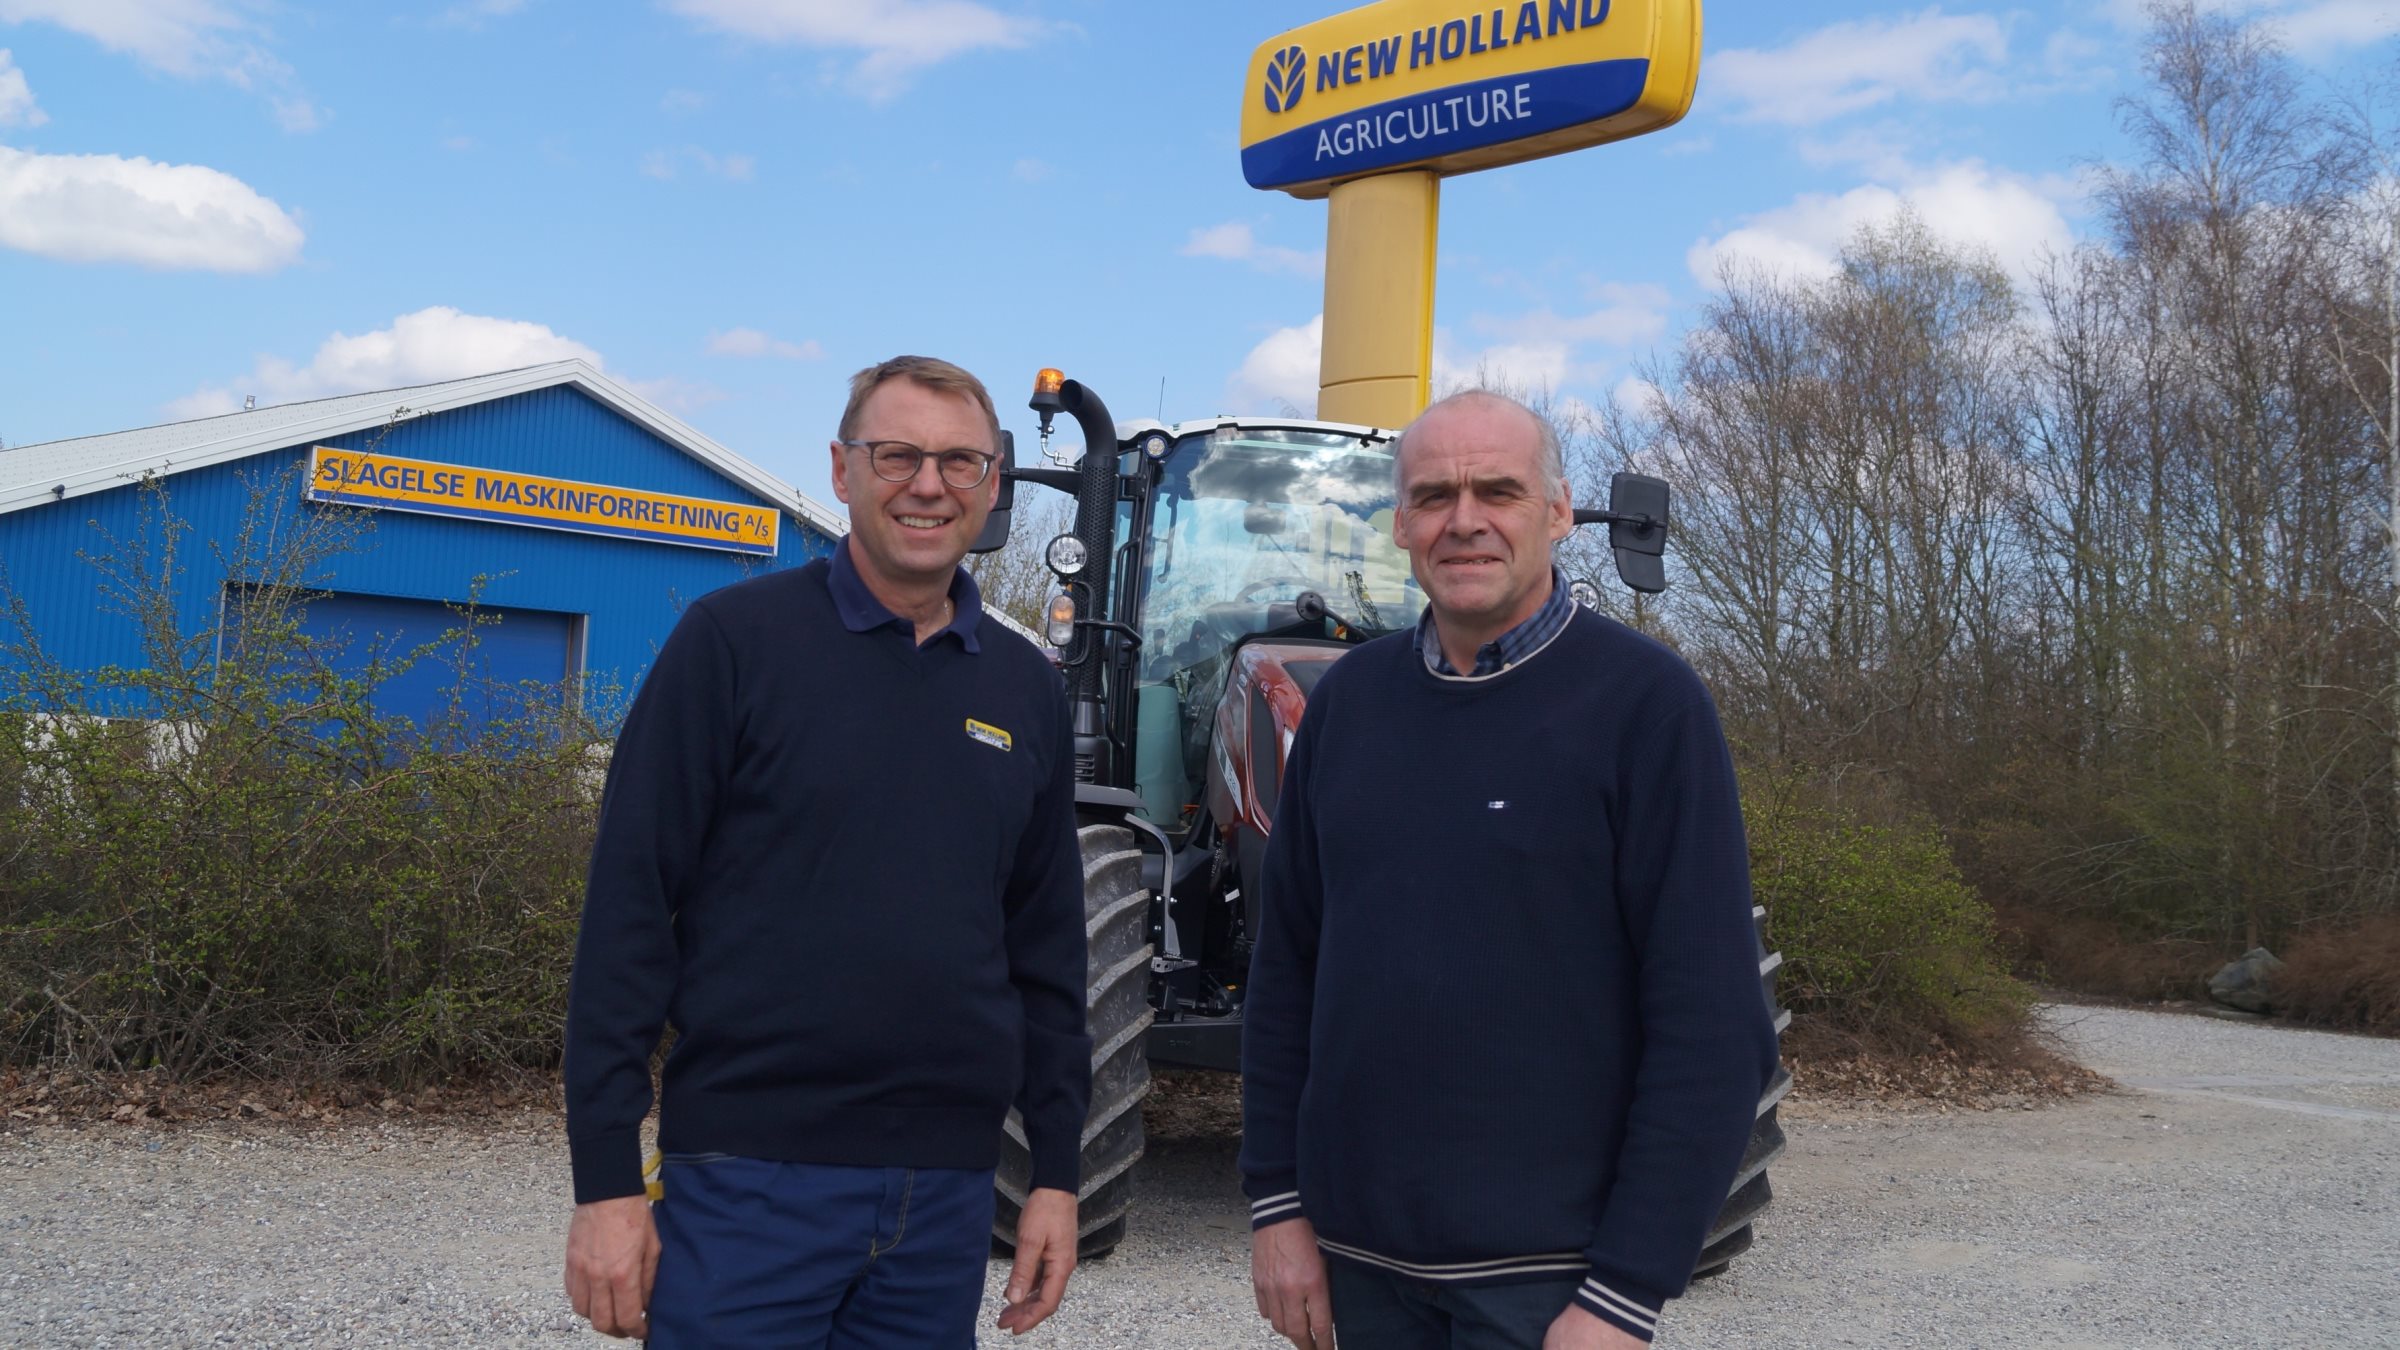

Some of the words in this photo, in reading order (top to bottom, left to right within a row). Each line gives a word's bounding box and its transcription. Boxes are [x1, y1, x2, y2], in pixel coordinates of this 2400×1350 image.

[1316, 36, 1403, 92] NEW
[1410, 0, 1611, 69] HOLLAND
[1315, 83, 1532, 161] AGRICULTURE
[322, 457, 465, 497] SLAGELSE
[475, 477, 740, 533] MASKINFORRETNING
[744, 514, 769, 537] A/S
